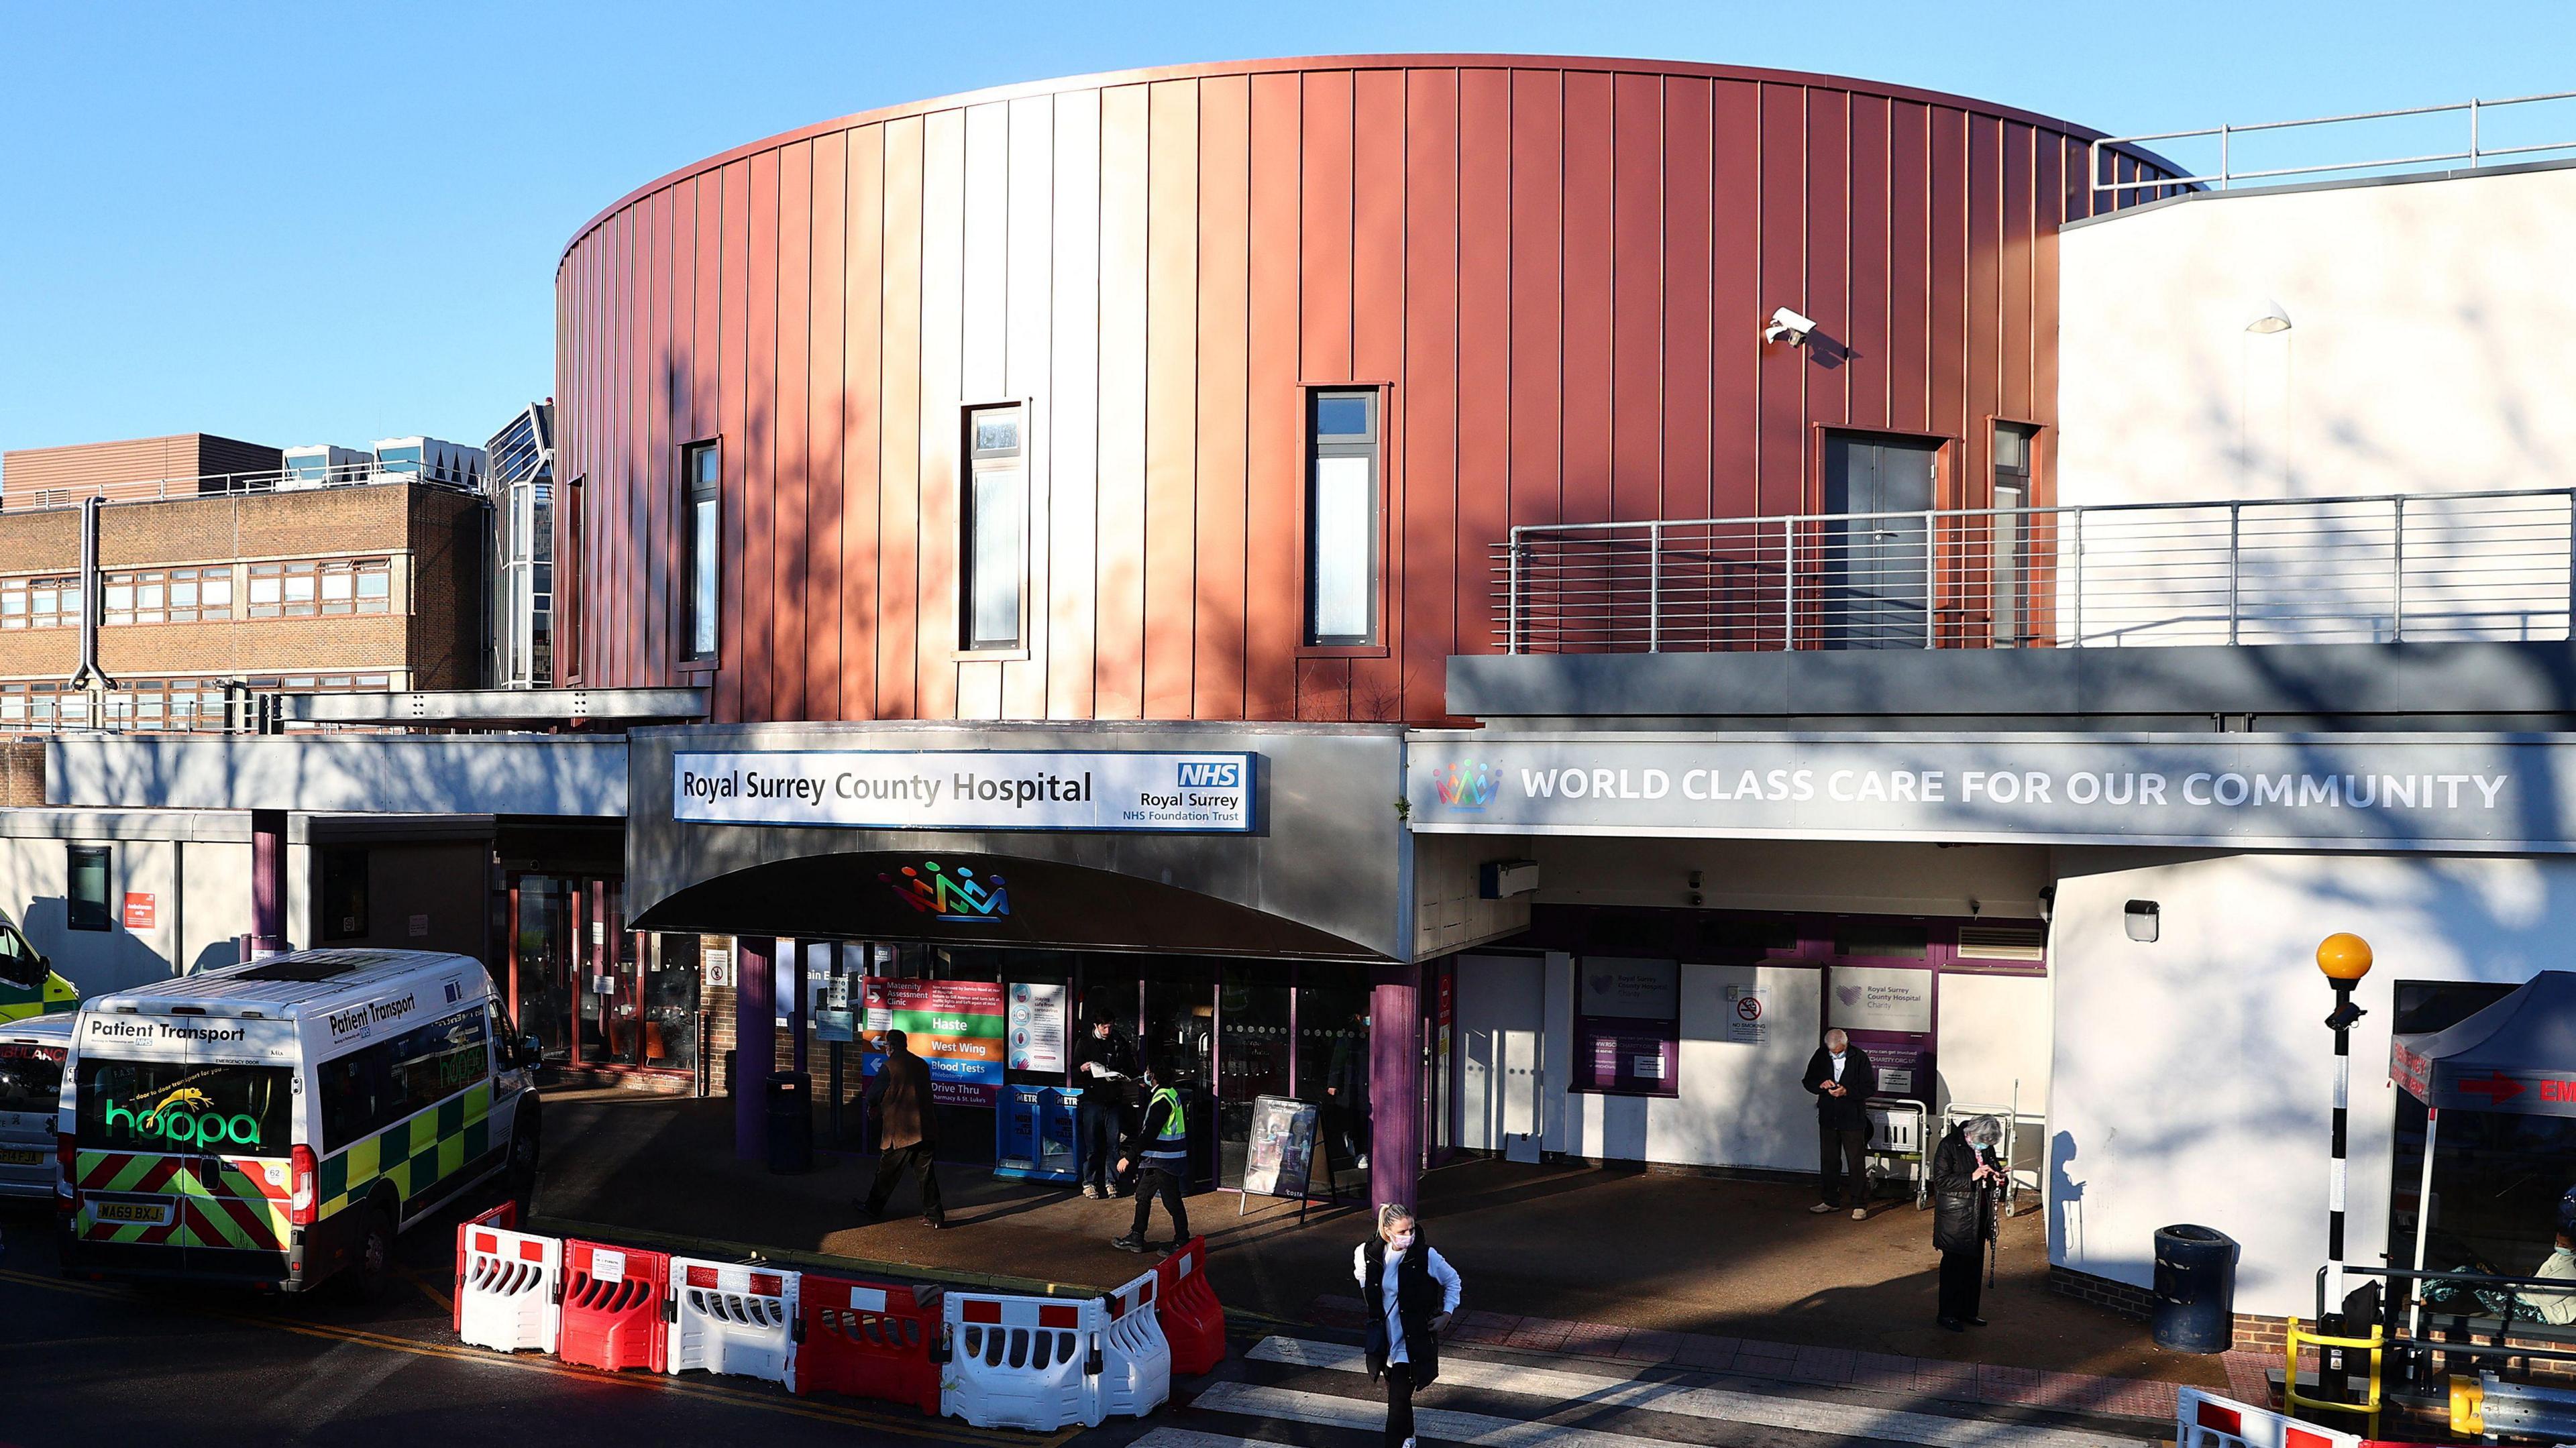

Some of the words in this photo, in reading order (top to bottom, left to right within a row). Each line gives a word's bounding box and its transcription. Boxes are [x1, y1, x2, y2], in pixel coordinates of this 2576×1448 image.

[1179, 763, 1238, 786] NHS
[684, 770, 738, 804] Royal
[747, 771, 826, 806] Surrey
[836, 773, 941, 807] County
[953, 772, 1091, 808] Hospital
[1520, 767, 1670, 799] WORLD
[1682, 768, 1813, 801] CLASS
[1827, 769, 1945, 803] CARE
[1962, 771, 2053, 803] FOR
[2066, 772, 2167, 805] OUR
[2182, 773, 2508, 809] COMMUNITY
[1140, 793, 1183, 810] Royal
[1189, 794, 1238, 810] Surrey
[1123, 812, 1145, 820] NHS
[1149, 811, 1209, 820] Foundation
[1212, 812, 1238, 821] Trust
[807, 970, 821, 981] ain
[887, 982, 921, 992] Maternity
[1888, 987, 1909, 995] Surrey
[887, 990, 928, 999] Assessment
[1868, 993, 1891, 1001] County
[887, 998, 906, 1006] Clinic
[1868, 1001, 1891, 1010] Charity
[329, 1007, 368, 1036] Patient
[368, 993, 415, 1023] Transport
[932, 1017, 967, 1031] Haste
[92, 1021, 154, 1036] Patient
[160, 1023, 245, 1044] Transport
[360, 1025, 370, 1038] NHS
[136, 1038, 152, 1046] NHS
[931, 1040, 957, 1052] West
[959, 1042, 986, 1056] Wing
[0, 1046, 68, 1062] BULANC
[931, 1061, 959, 1072] Blood
[961, 1062, 985, 1073] Tests
[932, 1072, 963, 1080] Phlebotomy
[136, 1091, 150, 1101] door
[158, 1084, 171, 1093] door
[172, 1073, 200, 1089] transport
[211, 1067, 221, 1075] you
[931, 1082, 955, 1093] Drive
[958, 1084, 979, 1095] Thru
[933, 1094, 955, 1102] harmacy
[1016, 1093, 1037, 1103] METR
[1057, 1095, 1077, 1105] METR
[106, 1099, 260, 1152] hoppa
[19, 1152, 37, 1162] FJA
[101, 1205, 132, 1218] WA69
[135, 1207, 159, 1220] BXJ
